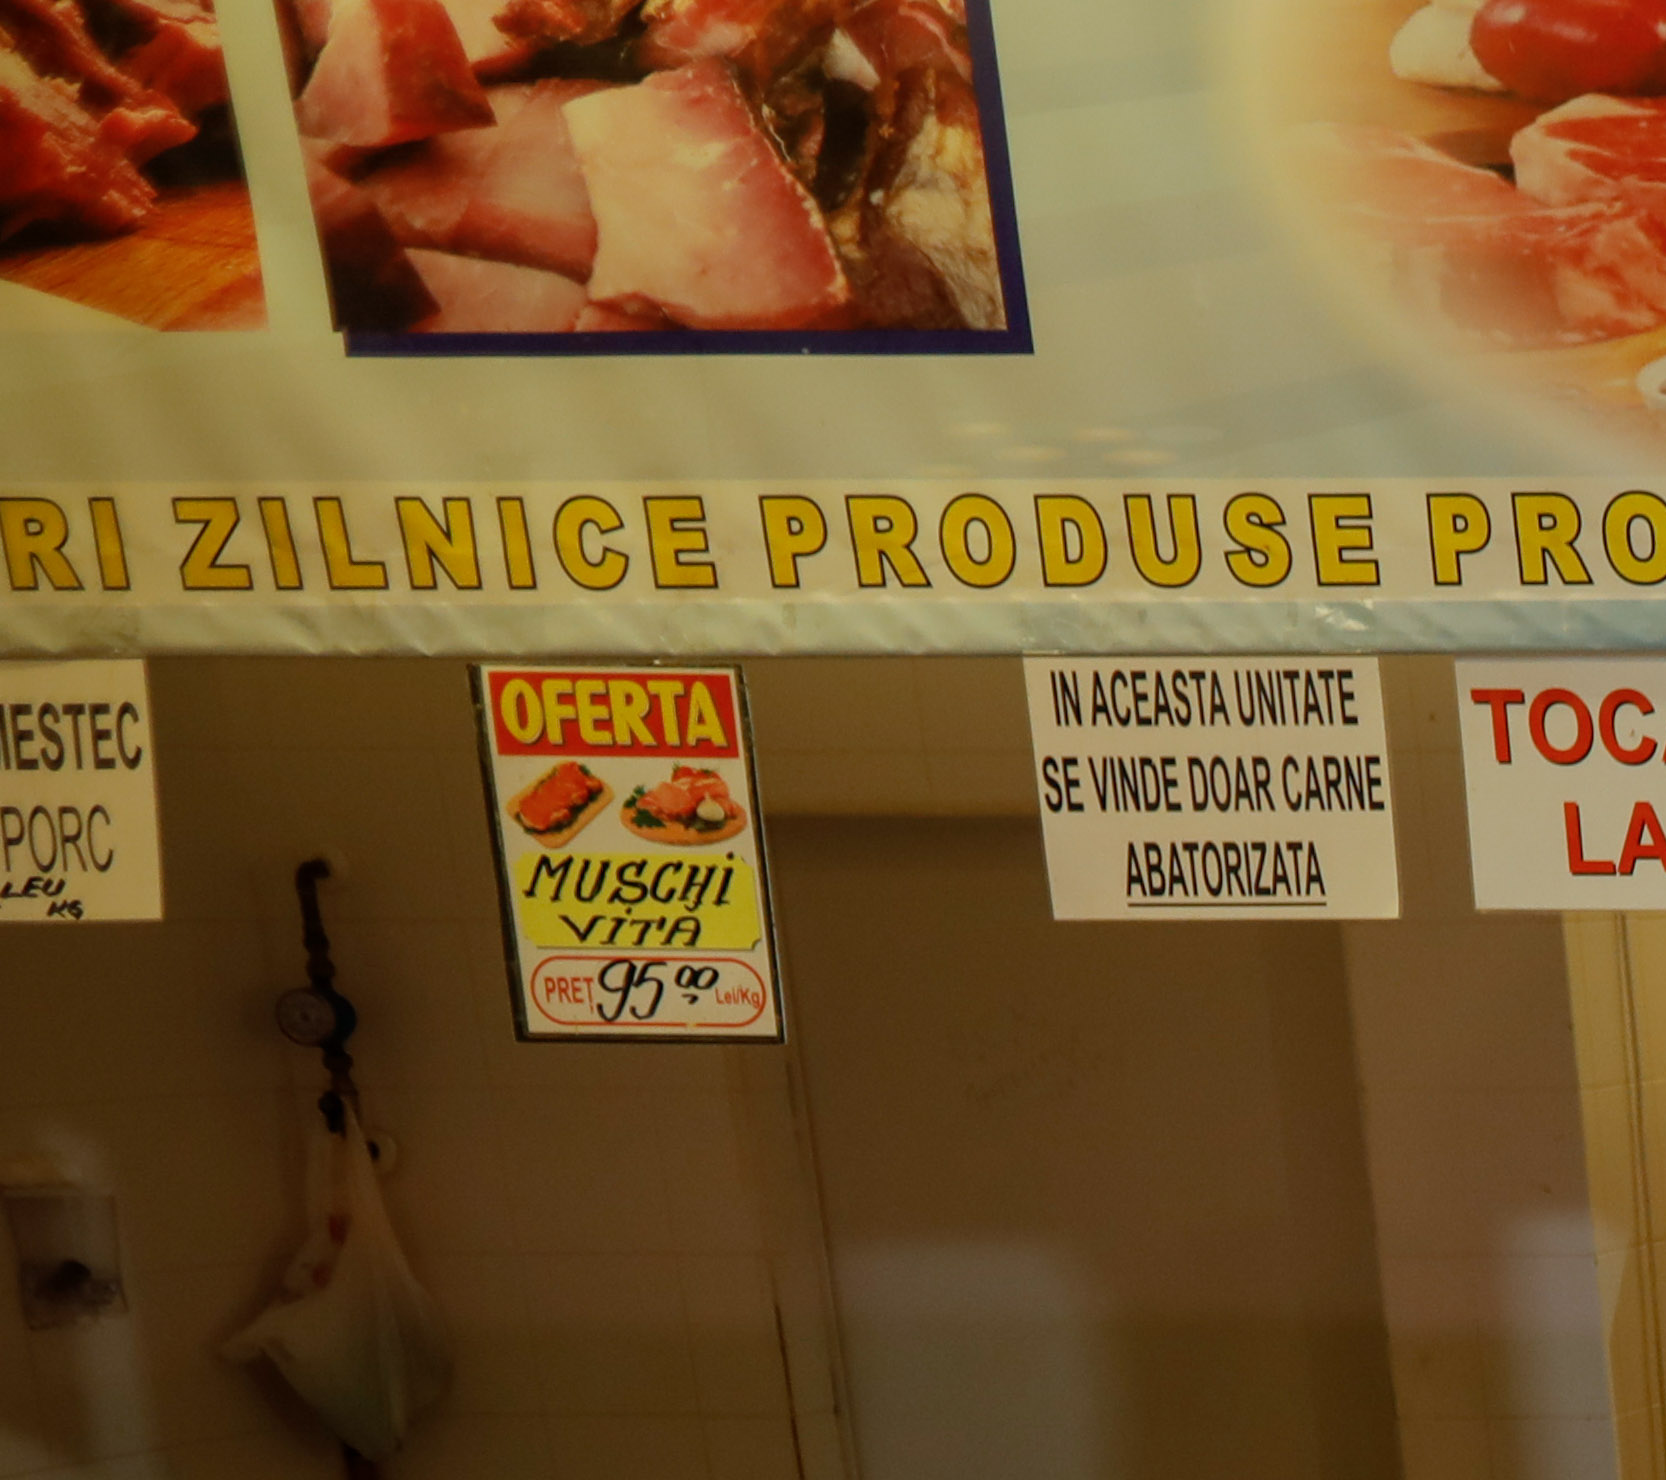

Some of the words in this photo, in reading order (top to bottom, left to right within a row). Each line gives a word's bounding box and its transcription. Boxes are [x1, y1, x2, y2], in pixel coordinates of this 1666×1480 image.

[0, 496, 130, 590] RI
[172, 496, 718, 590] ZILNICE
[759, 492, 1380, 588] PRODUSE
[500, 678, 729, 748] OFERTA
[1051, 671, 1082, 727] IN
[1087, 670, 1228, 727] ACEASTA
[1233, 670, 1360, 728] UNITATE
[1042, 755, 1083, 813] SE
[1087, 755, 1181, 813] VINDE
[1189, 755, 1275, 813] DOAR
[1280, 755, 1386, 814] CARNE
[0, 804, 114, 873] PORC
[1125, 842, 1326, 899] ABATORIZATA
[596, 958, 668, 1023] 95
